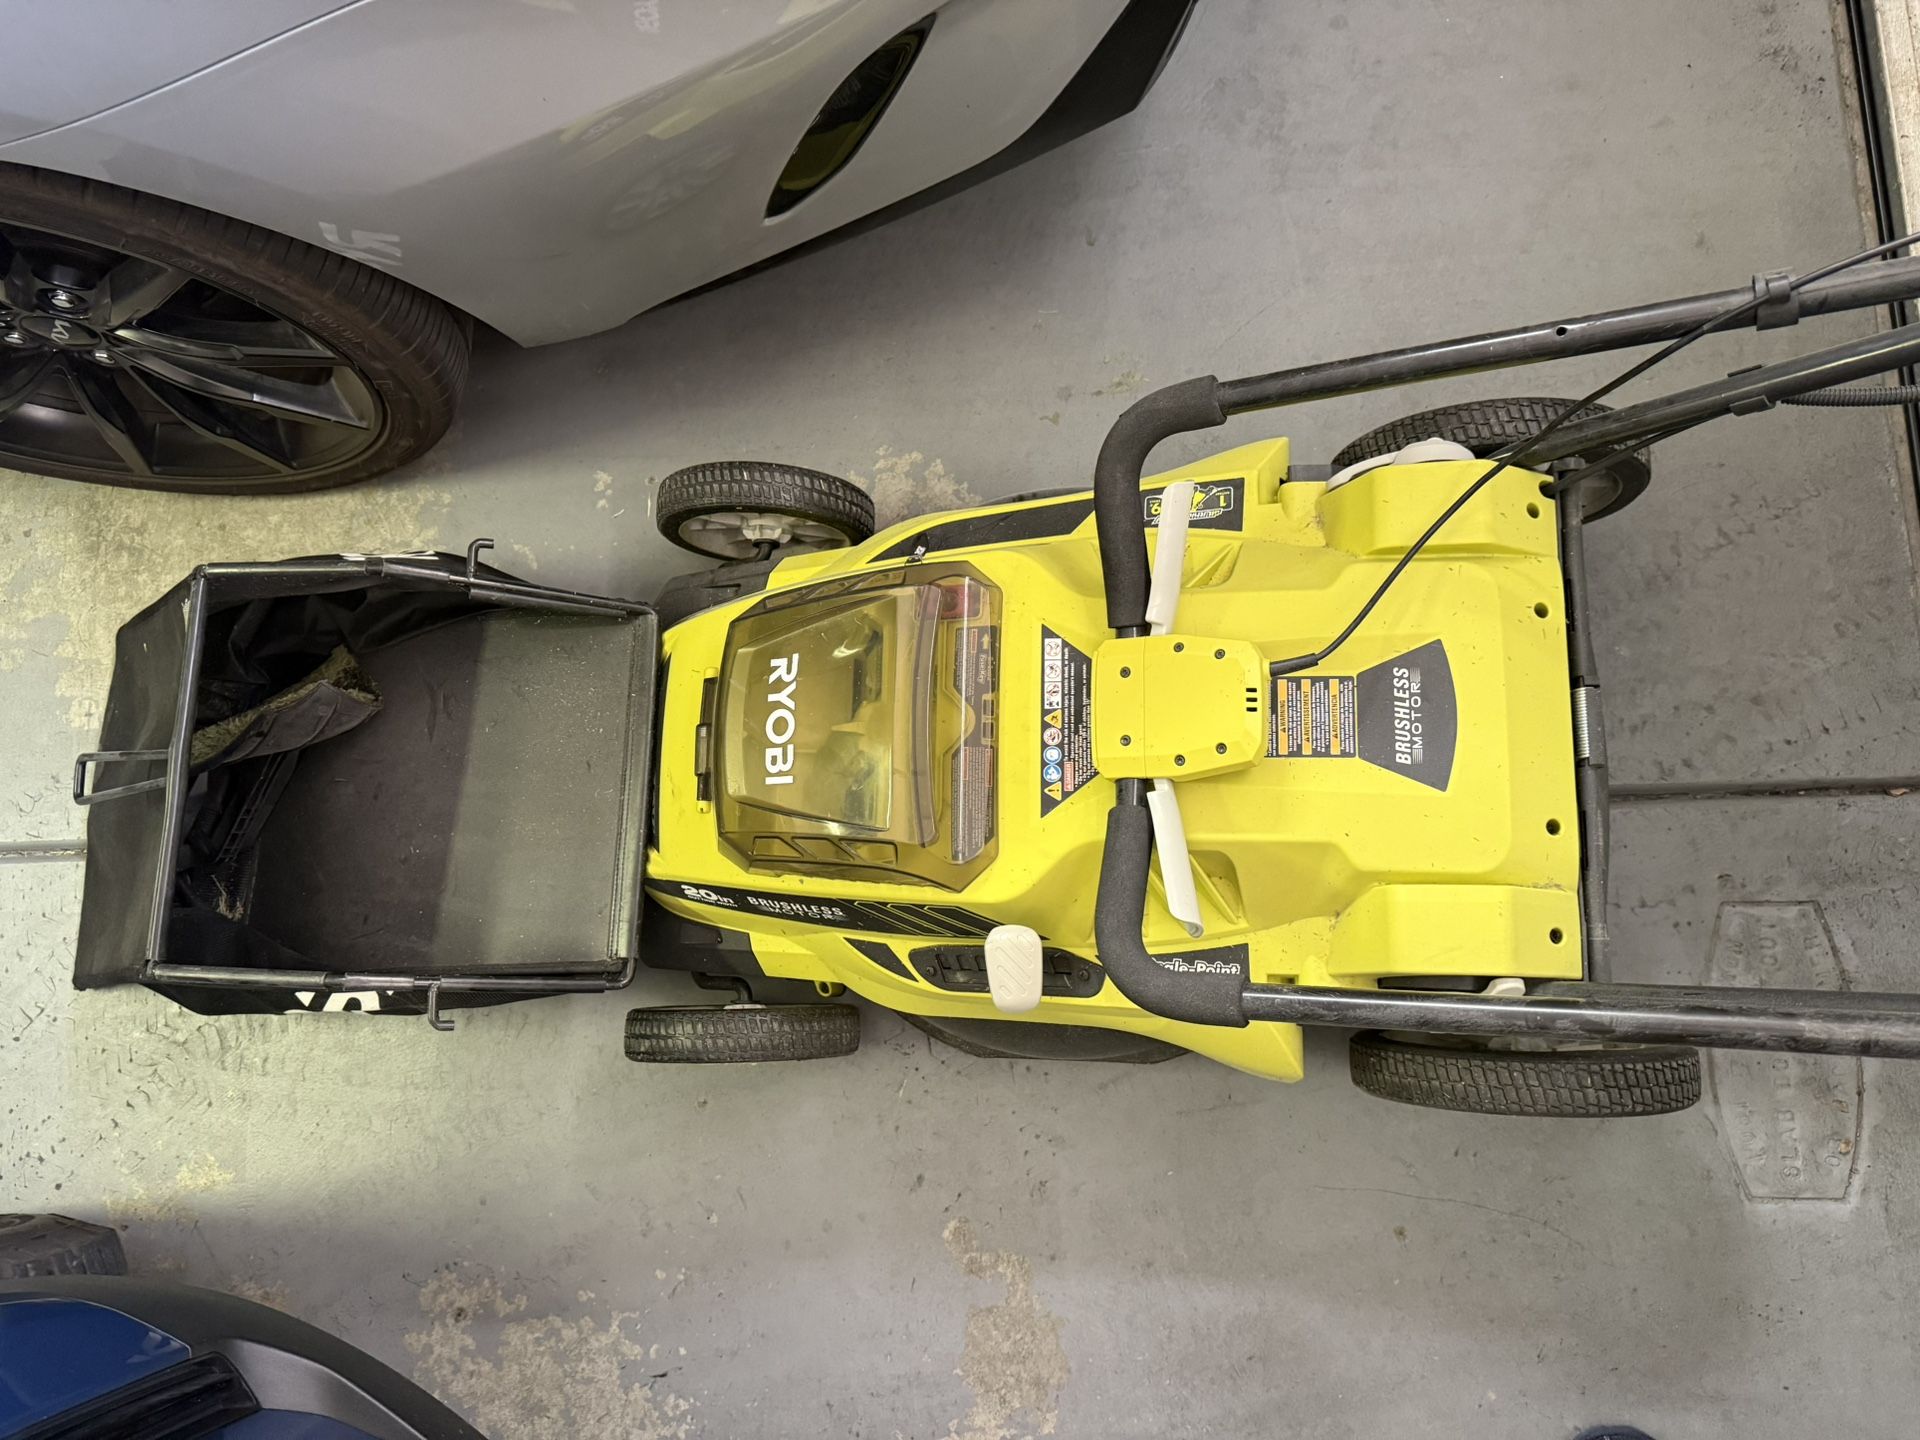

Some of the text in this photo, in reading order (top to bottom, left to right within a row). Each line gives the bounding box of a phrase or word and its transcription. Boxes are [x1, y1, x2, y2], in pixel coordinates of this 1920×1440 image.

[1219, 495, 1228, 507] 1
[763, 653, 800, 786] RYOBI
[1393, 667, 1412, 765] BRUSHLESS
[1411, 682, 1423, 748] MOTOR
[747, 896, 844, 916] BRUSHLESS
